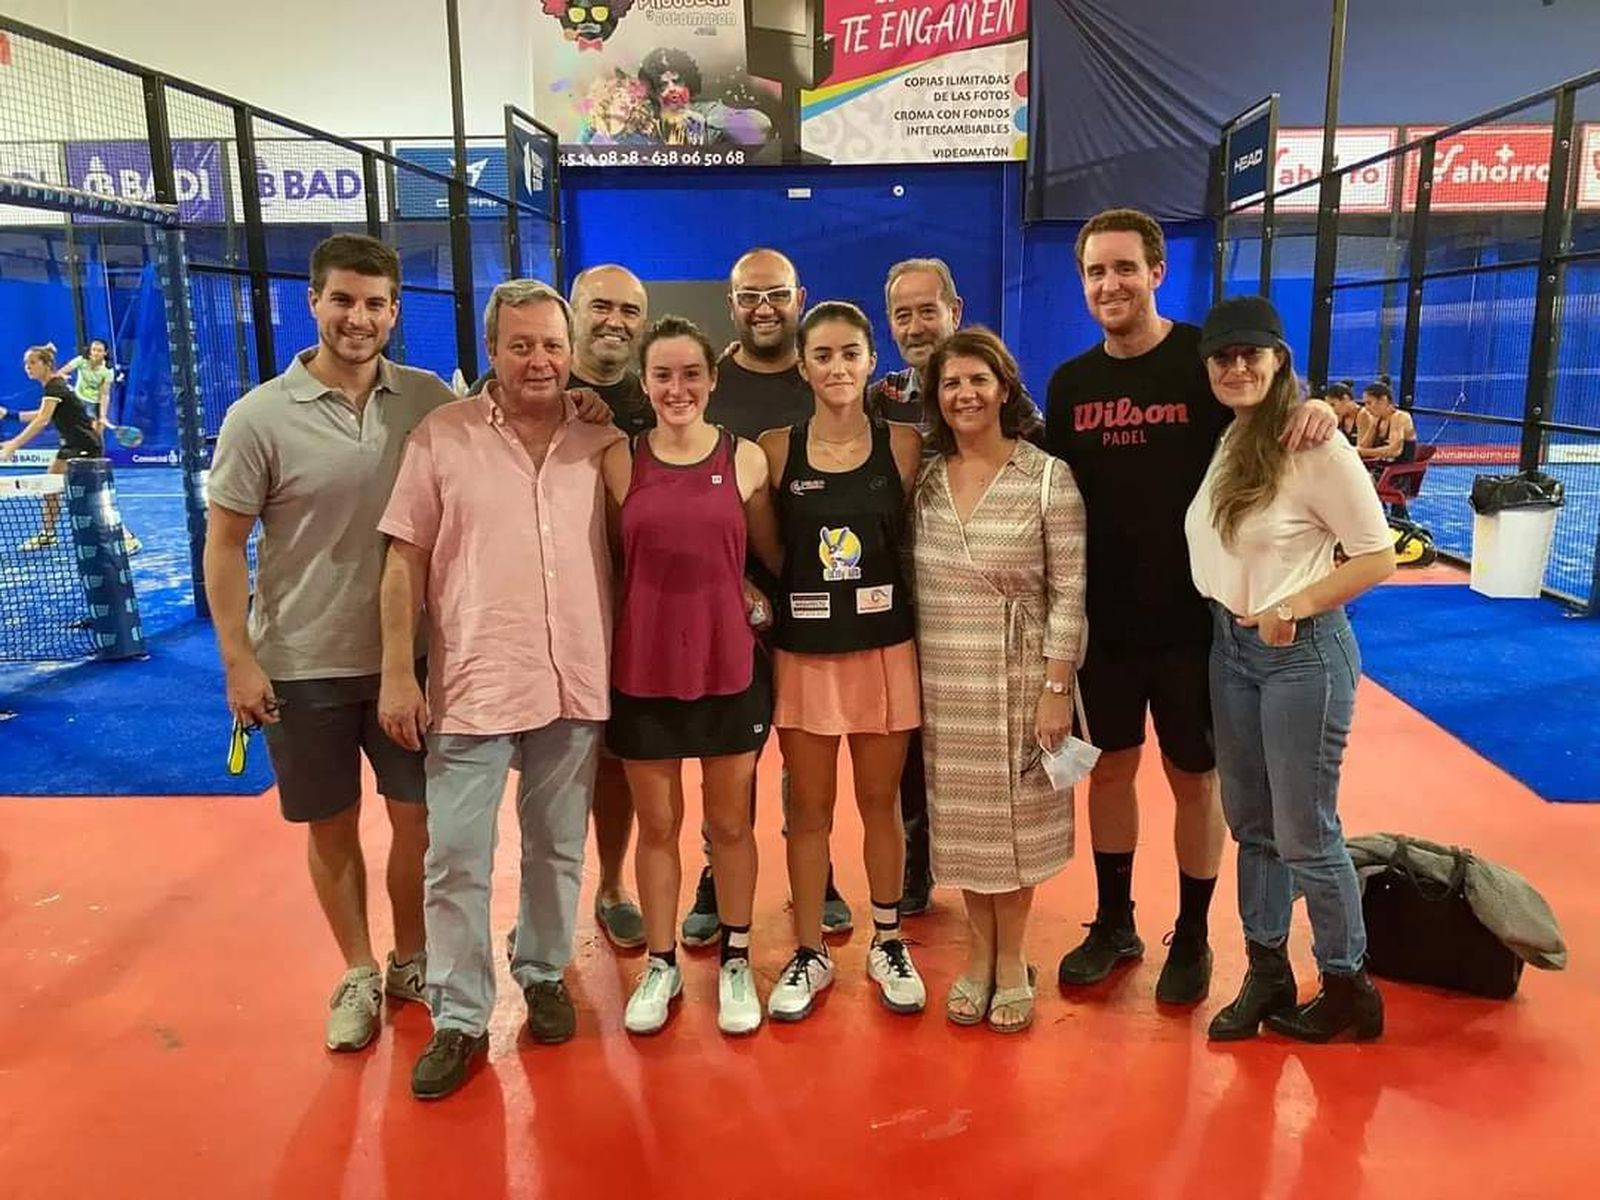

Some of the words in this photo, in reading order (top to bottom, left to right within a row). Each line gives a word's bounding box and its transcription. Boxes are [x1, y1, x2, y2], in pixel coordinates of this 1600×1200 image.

[840, 14, 872, 53] TE
[904, 76, 944, 88] COPIAS
[946, 74, 1010, 86] ILIMITADAS
[934, 91, 949, 102] DE
[951, 91, 971, 101] LAS
[974, 90, 1010, 101] FOTOS
[894, 109, 935, 121] CROMA
[937, 109, 960, 119] CON
[963, 108, 1010, 119] FONDOS
[907, 124, 1010, 136] INTERCAMBIABLES
[599, 151, 617, 166] 08
[620, 151, 639, 165] 28
[652, 151, 679, 166] 638
[682, 151, 701, 165] 06
[704, 153, 723, 167] 50
[725, 151, 745, 165] 68
[1234, 149, 1264, 174] HEAD
[1279, 164, 1380, 186] ahro
[284, 170, 362, 200] BAD
[1073, 397, 1188, 431] Wilson
[1102, 430, 1147, 446] PADEL
